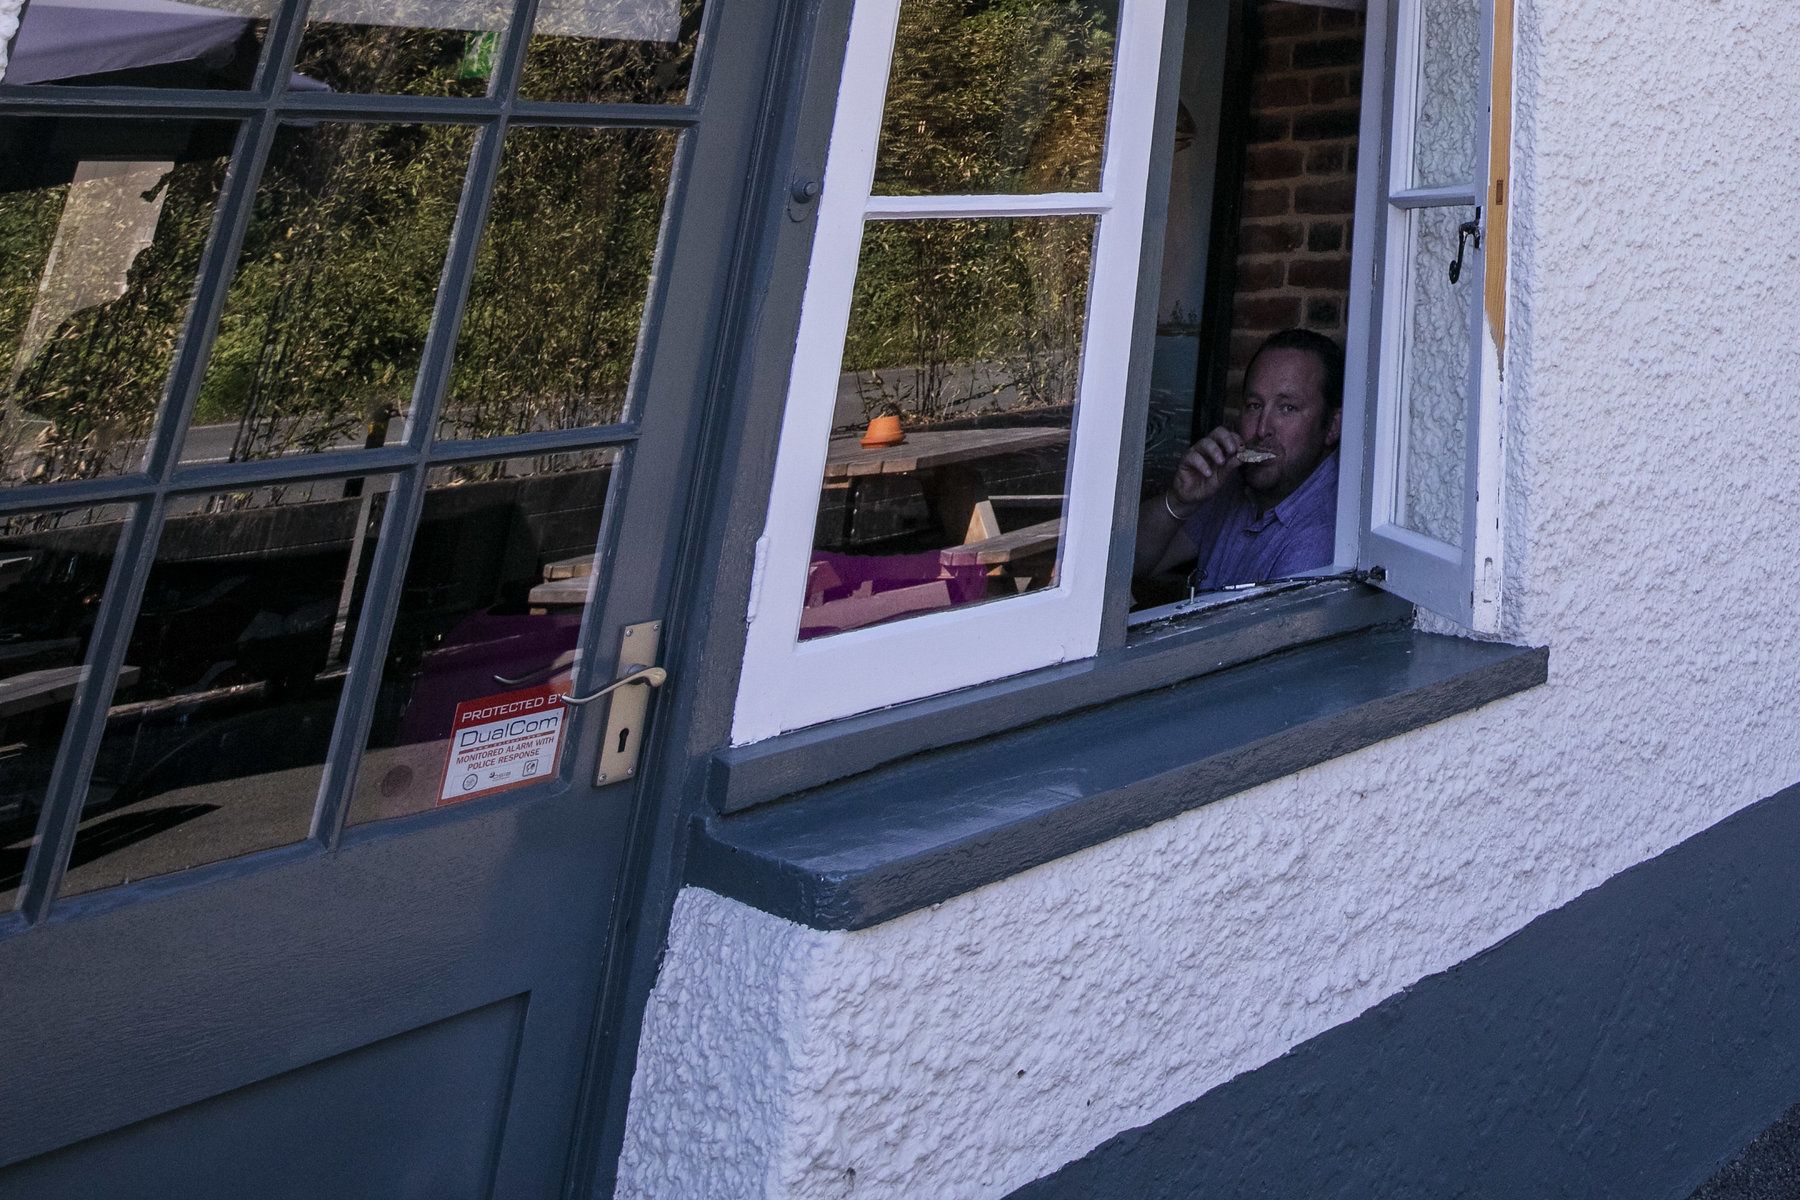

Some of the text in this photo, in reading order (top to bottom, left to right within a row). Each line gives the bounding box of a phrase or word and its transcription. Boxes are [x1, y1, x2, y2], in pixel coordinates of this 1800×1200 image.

[461, 696, 544, 723] PROTECTED
[460, 716, 558, 747] DualCom
[456, 747, 504, 764] MONITORED
[506, 740, 533, 753] ALARM
[535, 736, 555, 746] WITH
[467, 748, 540, 771] POLICE RESPONSE
